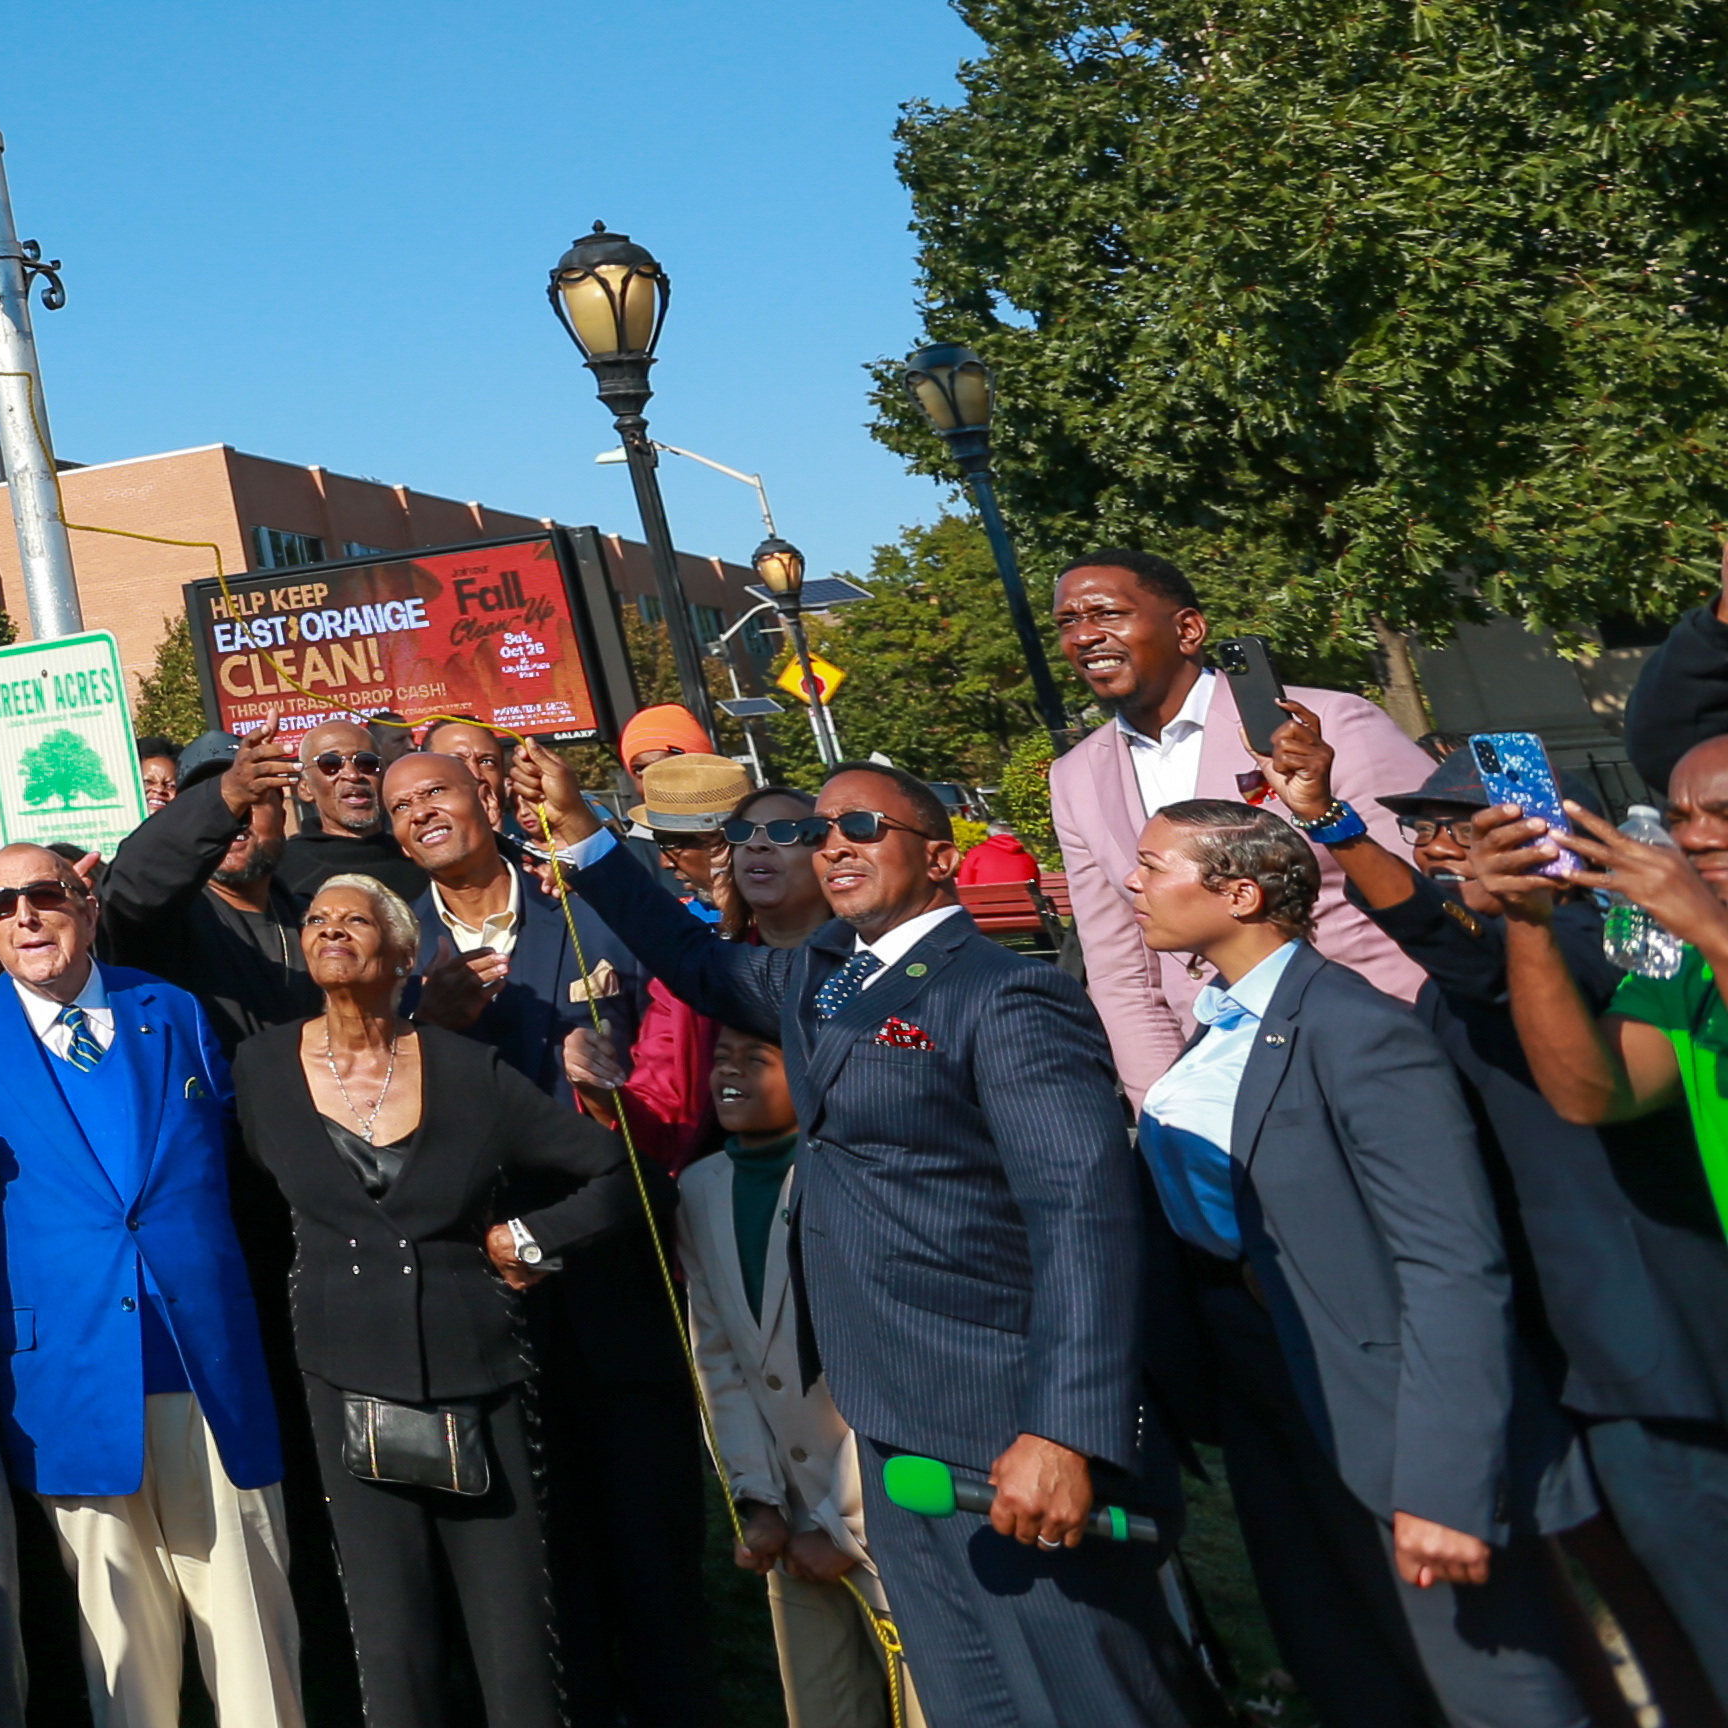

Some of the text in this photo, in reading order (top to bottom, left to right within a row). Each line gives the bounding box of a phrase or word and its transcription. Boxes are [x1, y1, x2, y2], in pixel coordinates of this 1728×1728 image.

[209, 582, 329, 620] HELP KEEP
[453, 570, 526, 615] Fall
[212, 597, 430, 653] EAST ORANGE
[218, 636, 385, 698] CLEAN!
[500, 642, 546, 658] Oct 26
[53, 667, 115, 710] ACRES
[228, 699, 285, 718] THROW
[347, 687, 393, 706] DROP
[397, 681, 448, 701] CASH!
[278, 712, 326, 732] START
[553, 729, 597, 741] GALAXY
